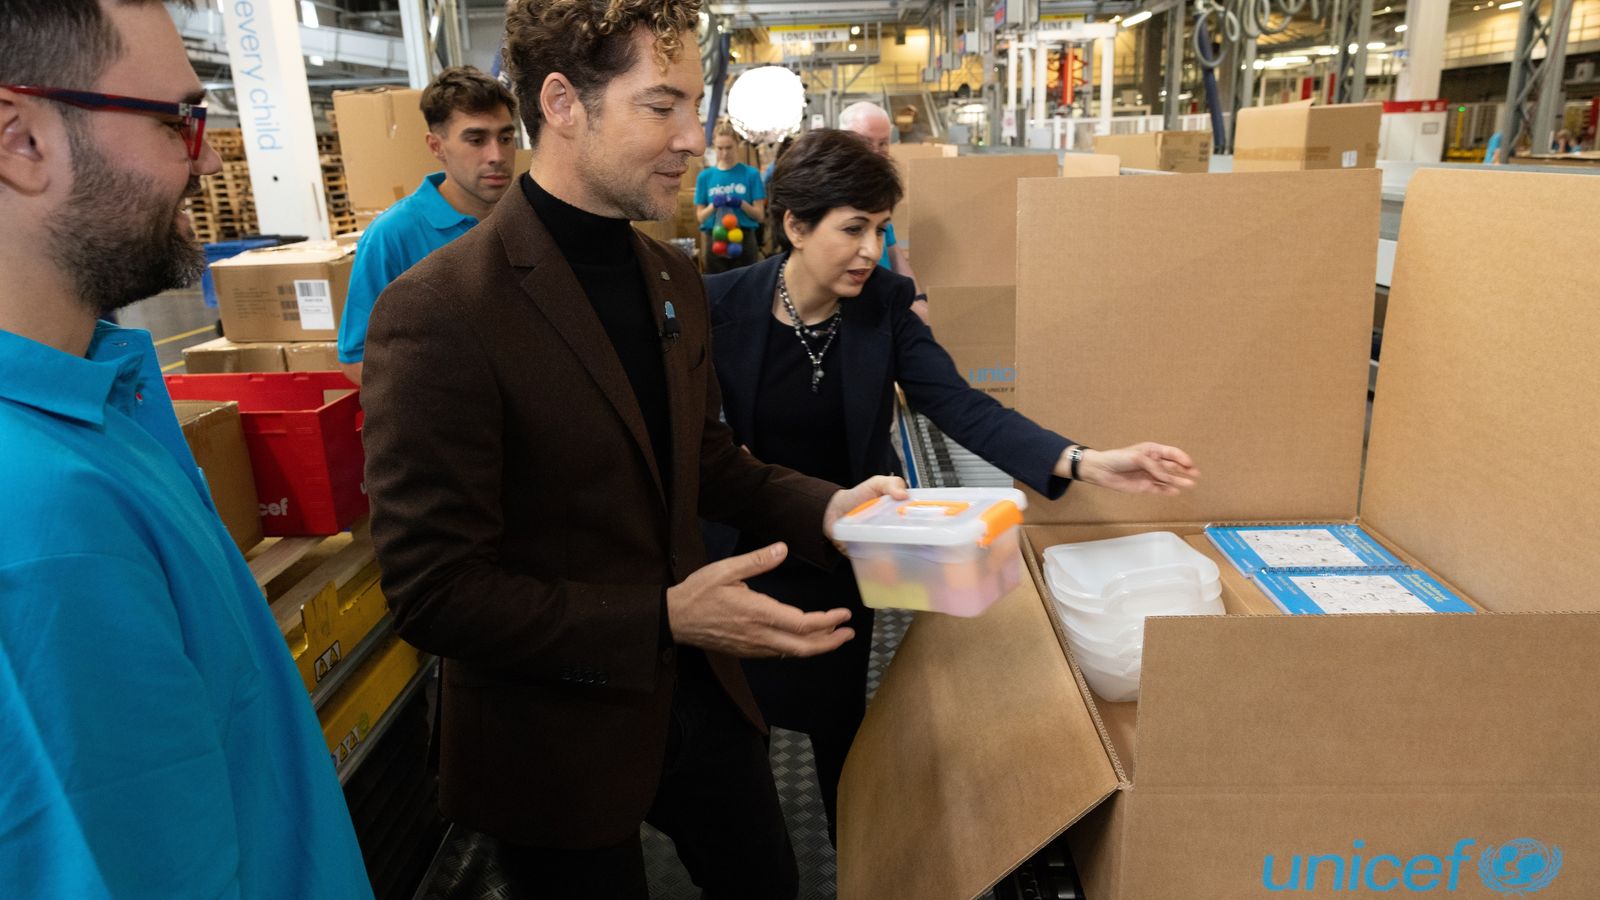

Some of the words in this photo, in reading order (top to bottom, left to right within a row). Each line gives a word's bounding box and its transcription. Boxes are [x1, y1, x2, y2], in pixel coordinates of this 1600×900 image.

[781, 31, 807, 41] LONG
[808, 30, 828, 40] LINE
[830, 30, 838, 39] A
[234, 0, 264, 81] every
[249, 88, 283, 150] child
[968, 362, 1015, 384] unic
[1262, 839, 1477, 892] unicef
